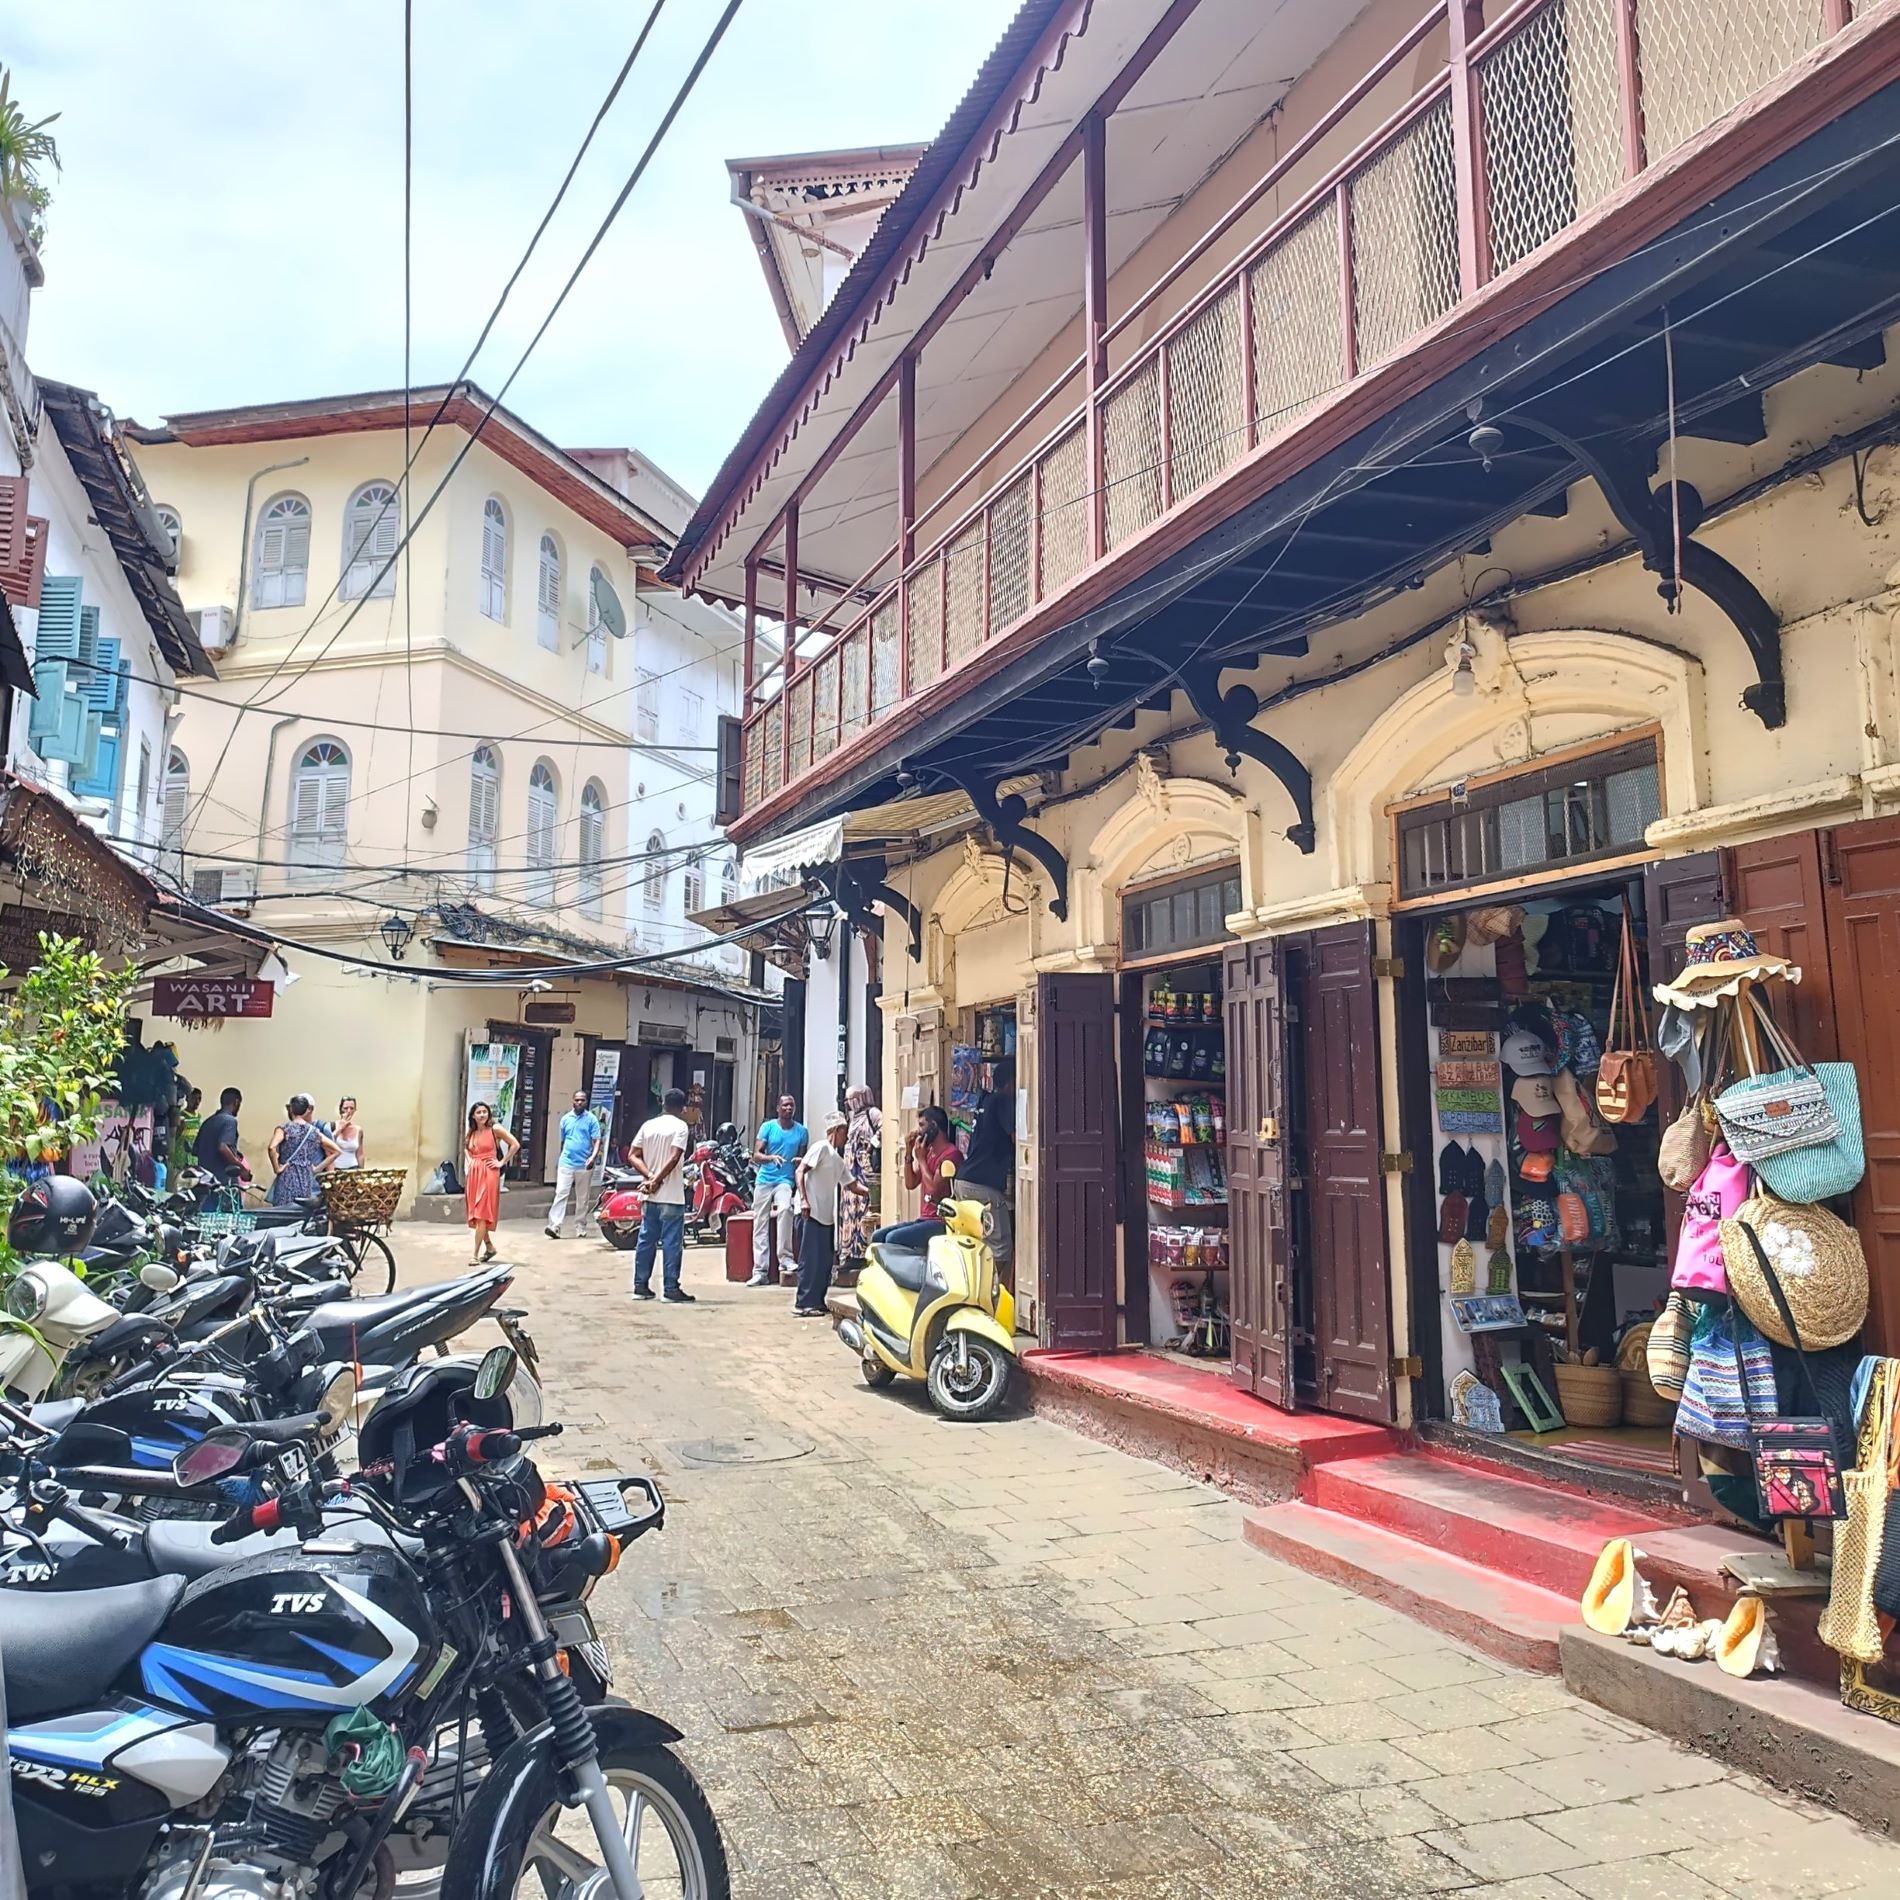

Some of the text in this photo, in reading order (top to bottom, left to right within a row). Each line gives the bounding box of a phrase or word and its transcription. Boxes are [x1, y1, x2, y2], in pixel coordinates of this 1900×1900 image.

[170, 983, 255, 993] WASANII
[177, 994, 250, 1013] ART
[1449, 1035, 1487, 1052] Zanzibar
[152, 1399, 188, 1411] TVS
[7, 1563, 59, 1583] TVS
[270, 1593, 327, 1614] TVS
[69, 1773, 120, 1790] HLX
[73, 1783, 109, 1797] 125
